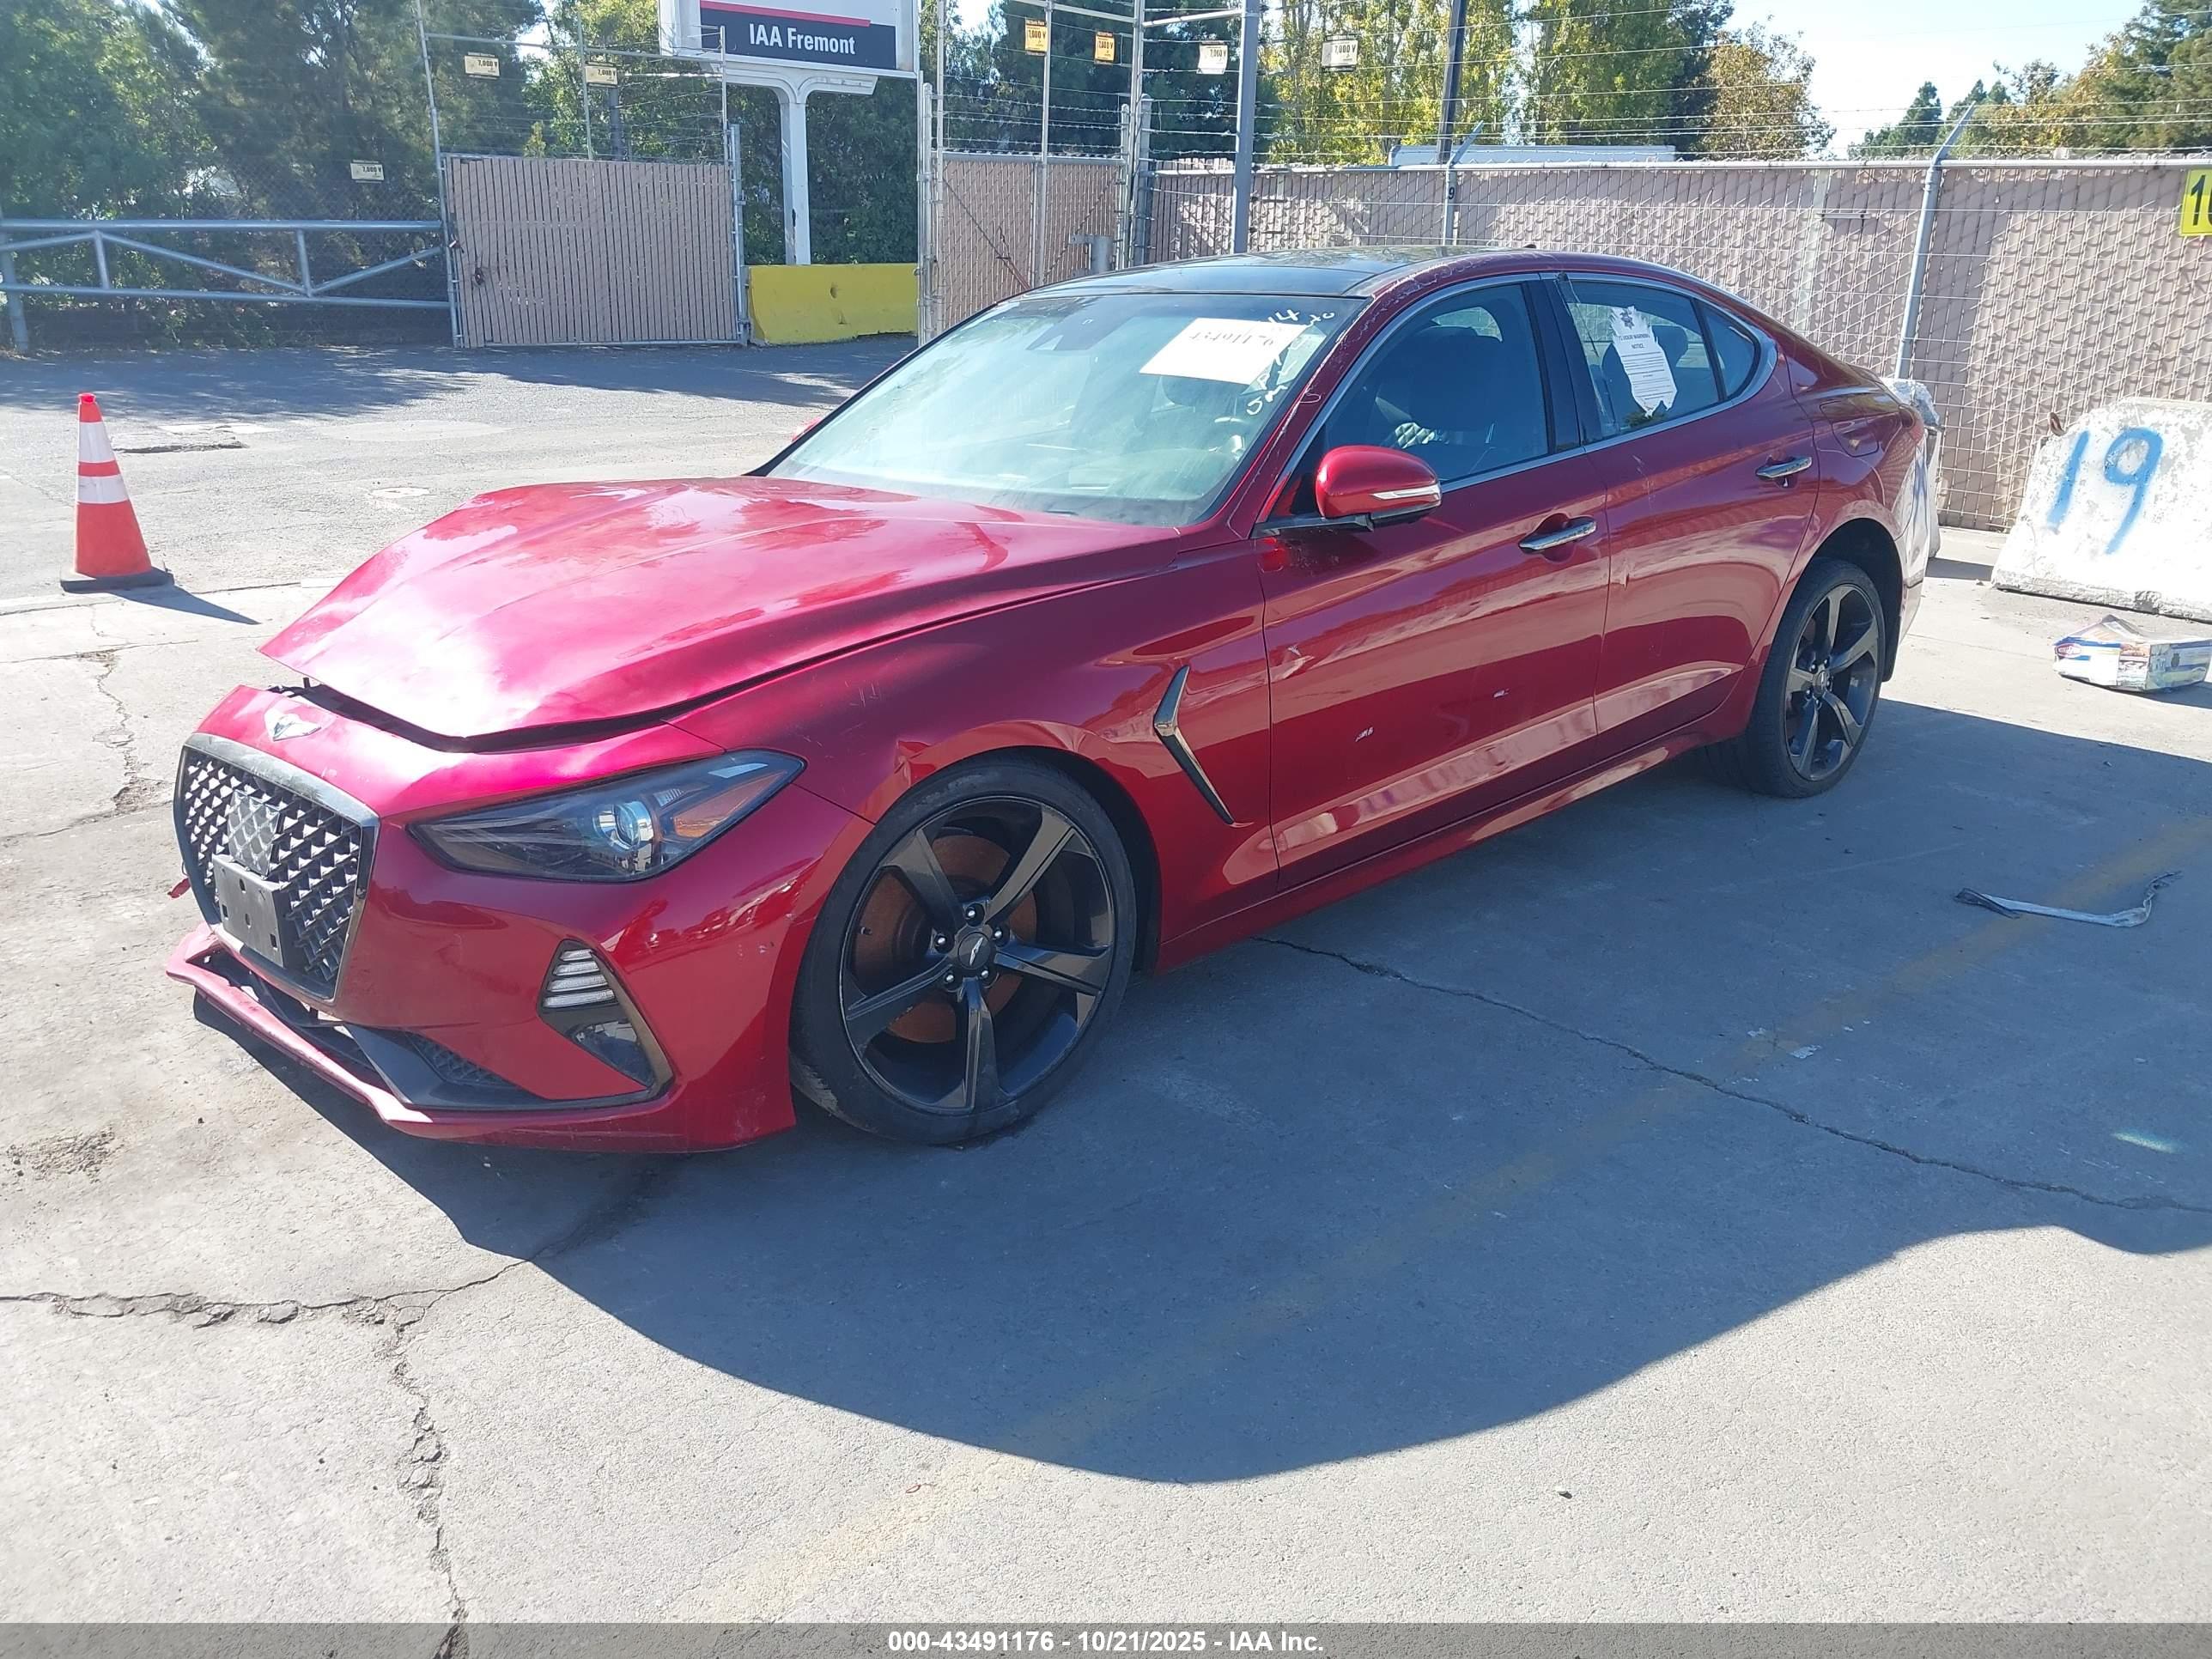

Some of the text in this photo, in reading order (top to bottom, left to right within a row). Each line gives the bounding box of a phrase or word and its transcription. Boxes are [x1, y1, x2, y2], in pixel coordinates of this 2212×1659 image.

[749, 23, 856, 55] IAA Fremont
[1352, 44, 1357, 52] V
[1448, 186, 1455, 200] 9
[2191, 174, 2212, 226] 1
[2046, 428, 2164, 556] 19
